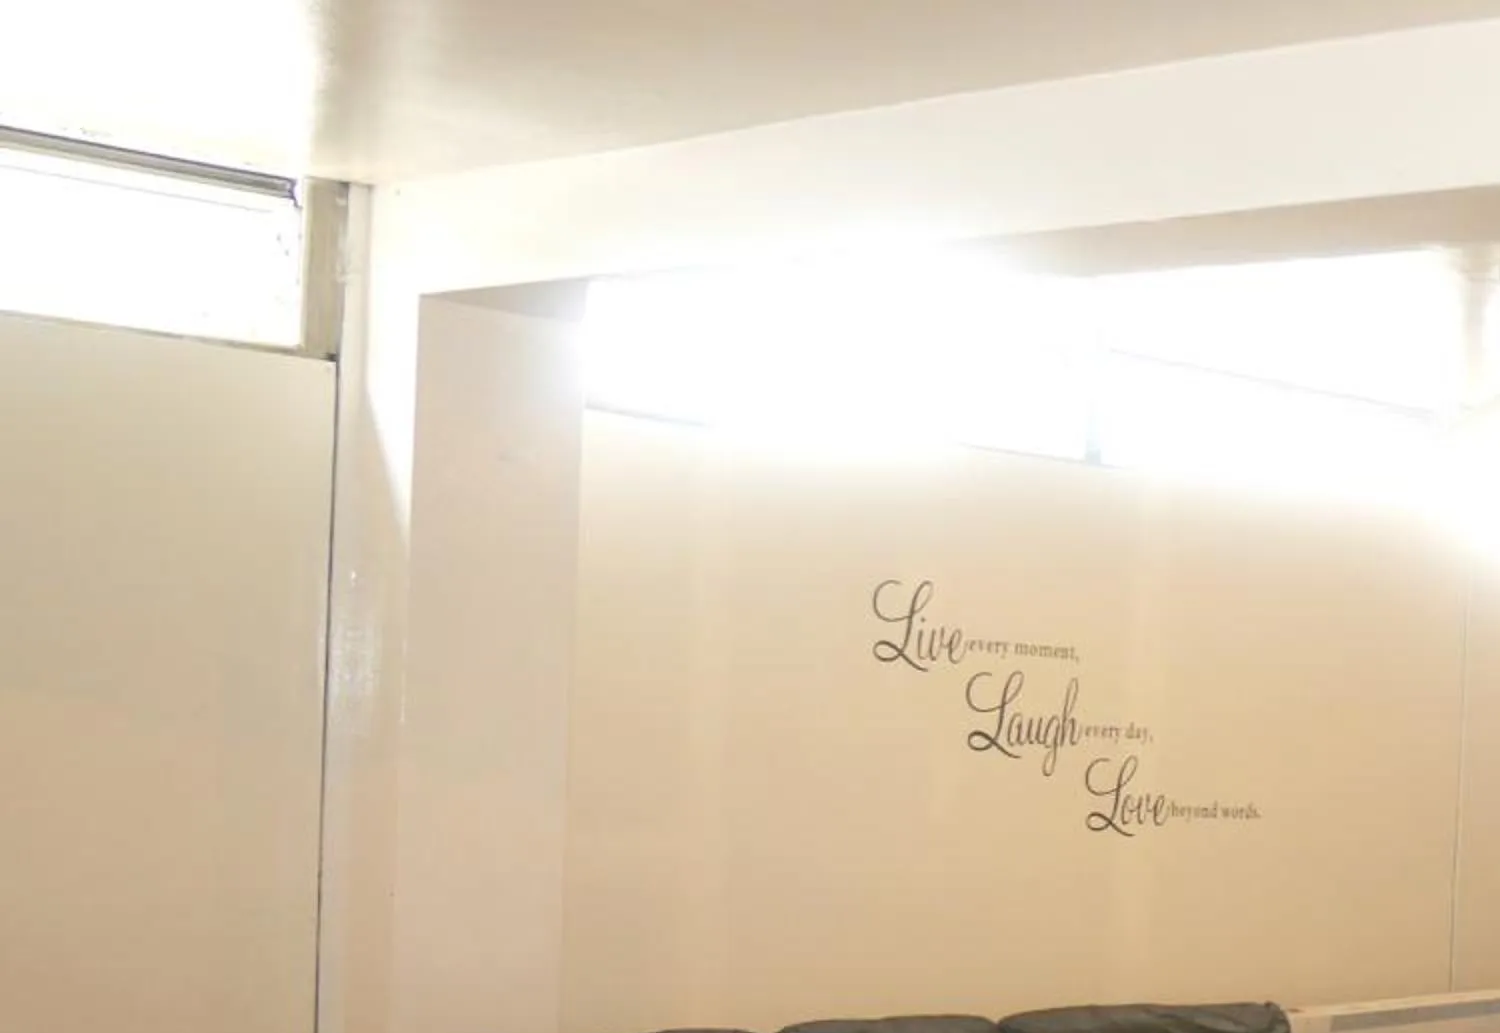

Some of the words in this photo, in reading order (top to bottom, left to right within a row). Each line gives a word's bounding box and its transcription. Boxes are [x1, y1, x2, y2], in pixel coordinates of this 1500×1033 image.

[872, 579, 968, 672] Live
[968, 639, 1011, 660] every
[965, 670, 1082, 777] Laugh
[1084, 755, 1169, 837] Love
